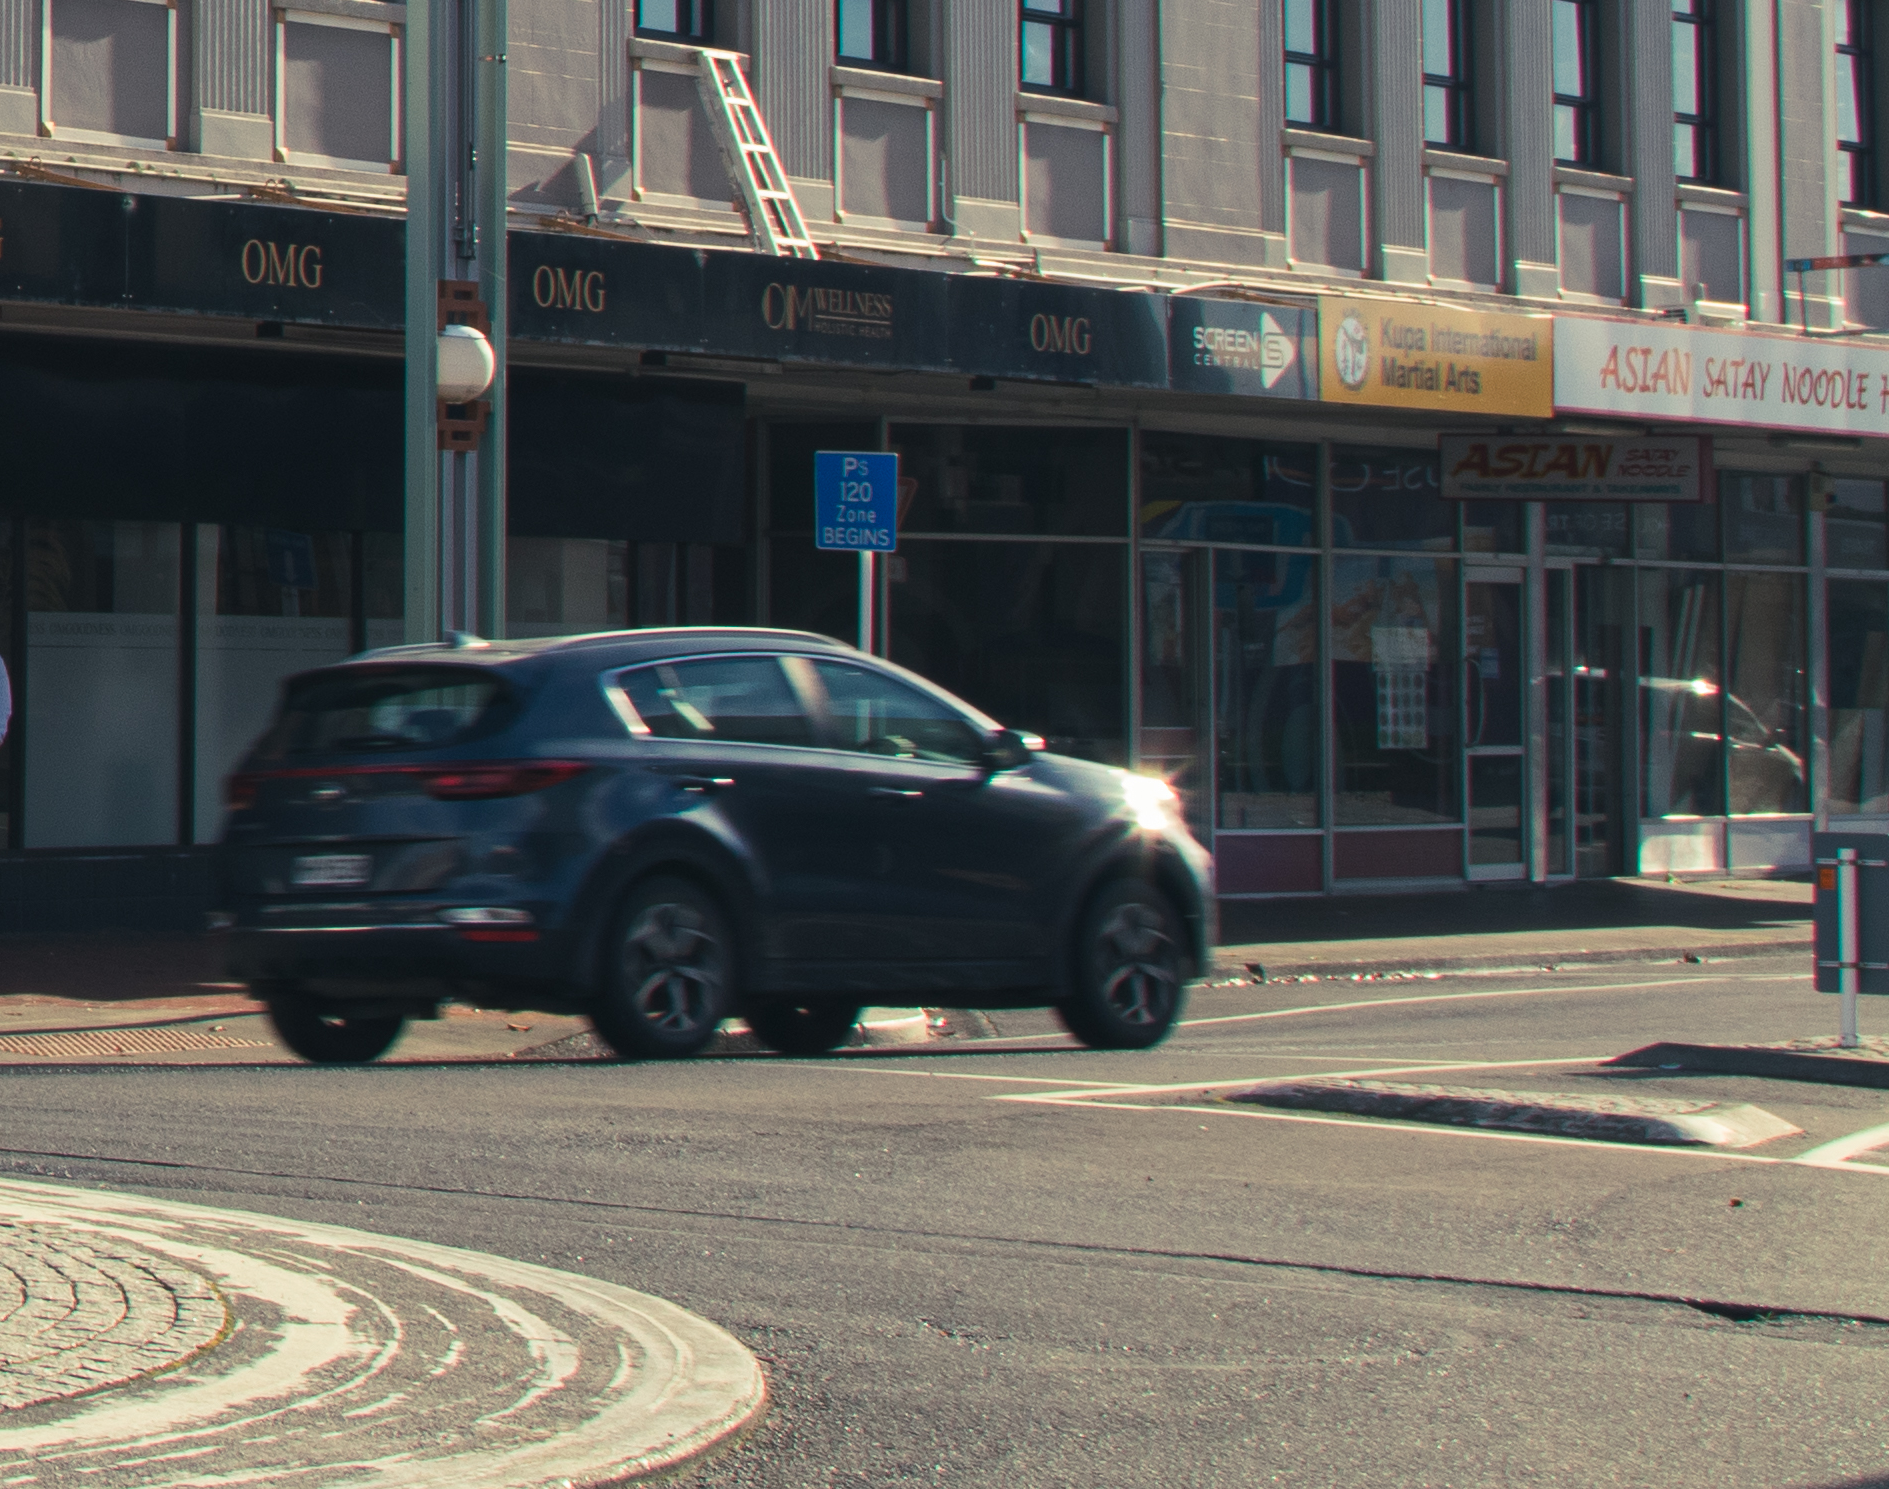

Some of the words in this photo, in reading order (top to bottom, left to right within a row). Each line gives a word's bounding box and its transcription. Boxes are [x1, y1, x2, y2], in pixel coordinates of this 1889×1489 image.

[241, 238, 324, 289] OMG
[532, 265, 606, 312] OMG
[814, 287, 893, 318] WELLNESS
[1030, 313, 1092, 355] OMG
[1193, 326, 1260, 352] SCREEN
[1380, 316, 1427, 358] Kupa
[1430, 322, 1539, 361] International
[1193, 353, 1260, 369] CENTRAL
[1380, 356, 1442, 391] Martial
[1445, 362, 1483, 394] Arts
[1599, 344, 1692, 396] ASIAN
[1702, 356, 1771, 401] SATAY
[1781, 361, 1870, 410] NOODLE
[1451, 443, 1614, 479] ASIAN
[1625, 448, 1680, 462] SATAY
[1617, 464, 1692, 478] NOODLE
[839, 481, 873, 502] 120
[836, 504, 877, 523] Zone
[823, 526, 890, 546] BEGINS
